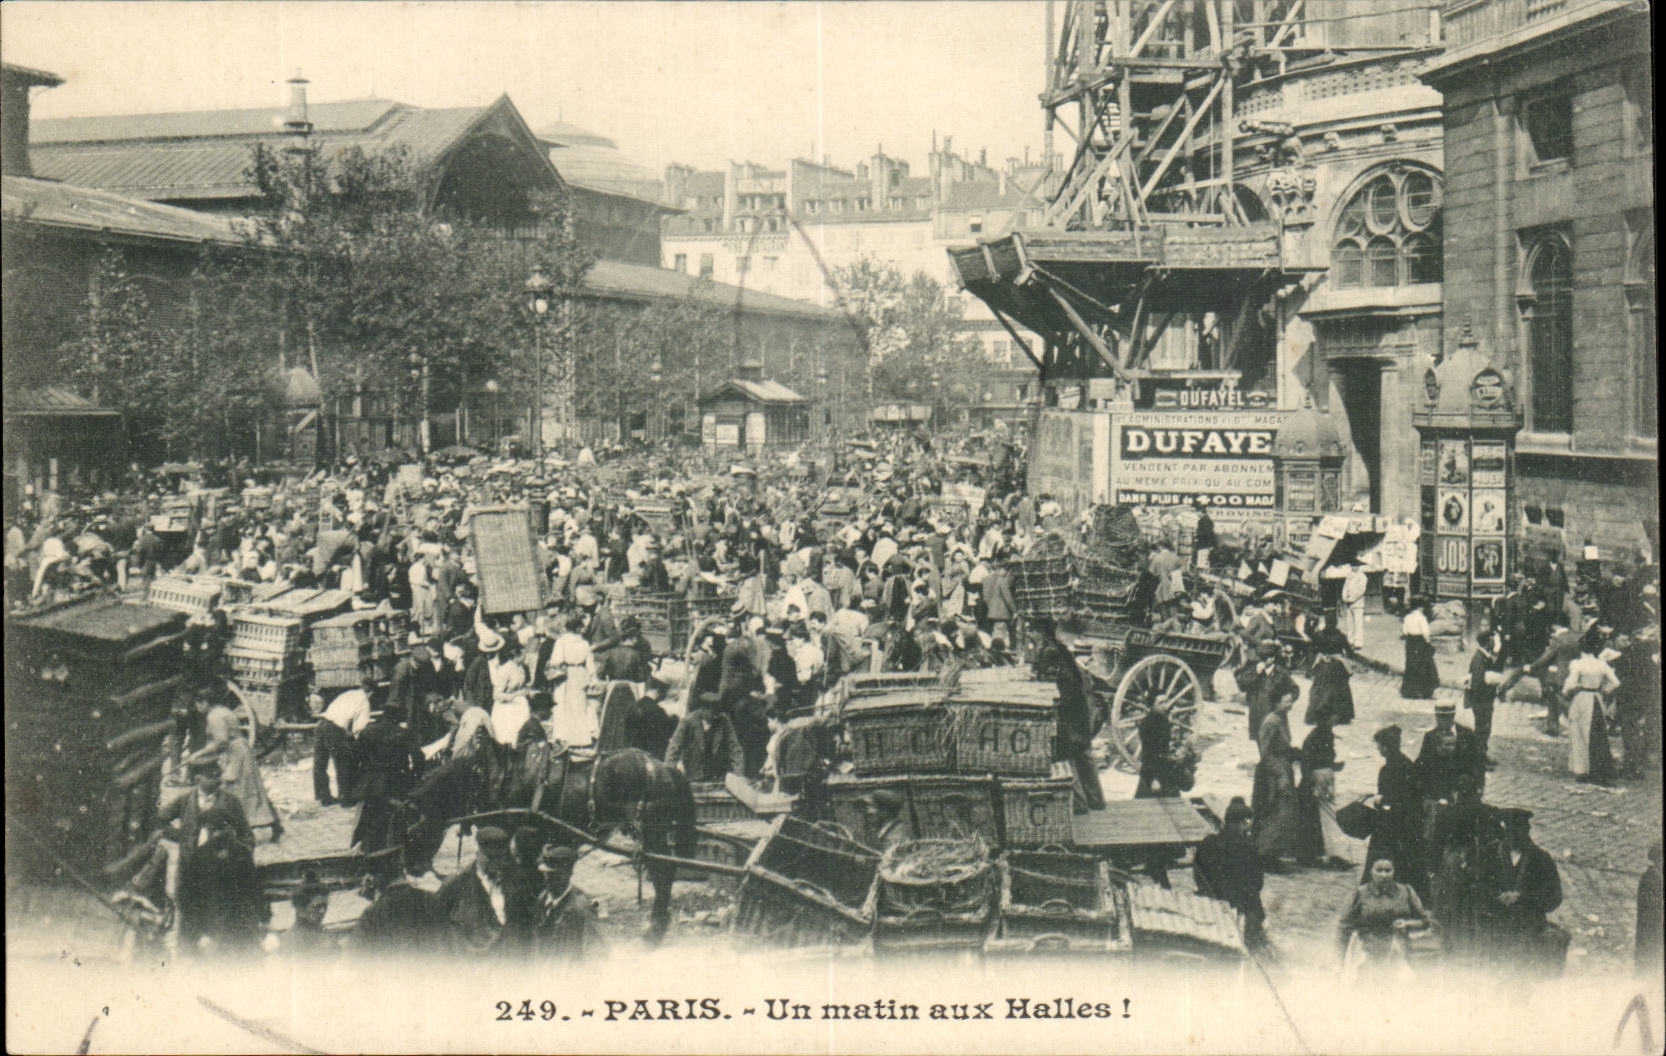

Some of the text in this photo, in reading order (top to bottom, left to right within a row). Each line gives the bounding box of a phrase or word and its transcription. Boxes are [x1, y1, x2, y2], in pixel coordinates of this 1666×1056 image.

[1180, 389, 1245, 407] DUFAYEL
[1126, 430, 1272, 454] DUFAYE
[1124, 463, 1178, 473] VENDENT
[1183, 463, 1207, 473] PAR
[1246, 479, 1272, 488] COM
[1151, 493, 1180, 505] PLUS
[1195, 494, 1243, 506] 400
[1438, 540, 1468, 573] JOB
